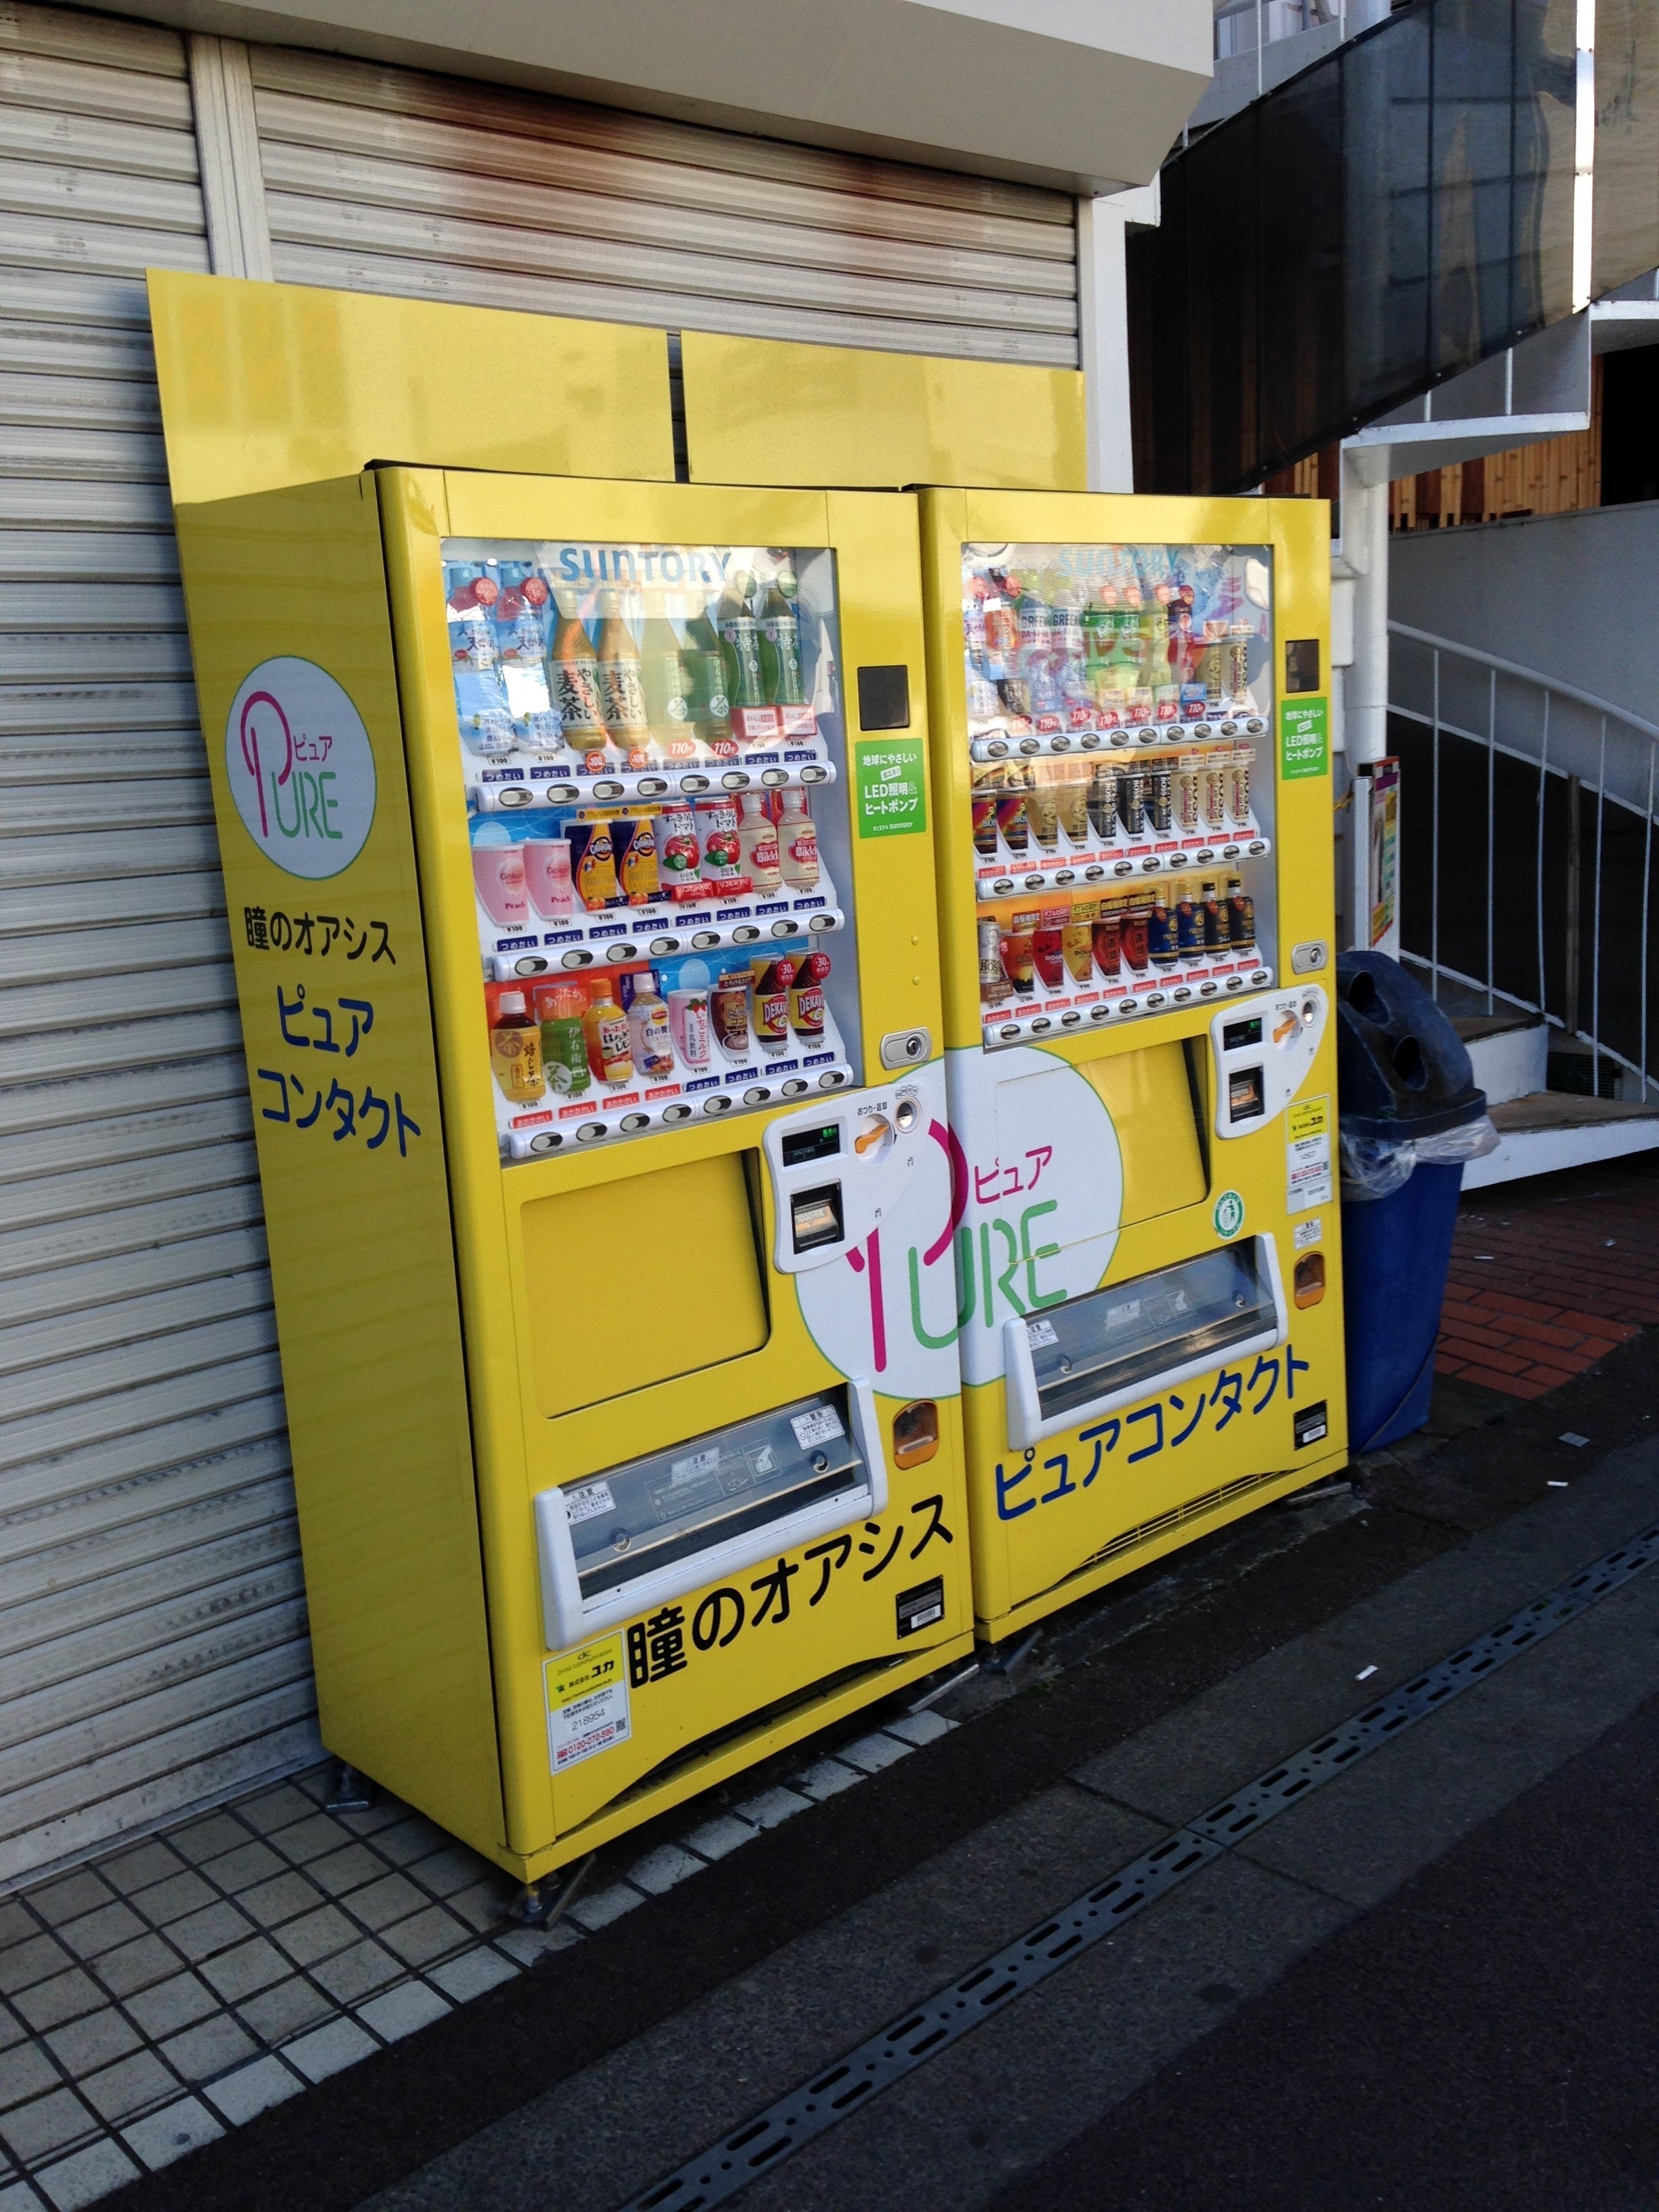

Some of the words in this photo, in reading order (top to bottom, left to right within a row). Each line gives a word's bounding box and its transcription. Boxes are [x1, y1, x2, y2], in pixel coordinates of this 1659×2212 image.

[1021, 615, 1049, 629] GREEN
[1052, 613, 1079, 626] GREEN
[556, 670, 582, 720] 麦茶
[294, 734, 333, 761] ピュア
[747, 756, 777, 764] つめたい
[785, 752, 816, 761] つめたい
[862, 753, 917, 766] 地球にやさしい
[241, 691, 342, 838] PURE
[486, 773, 521, 781] つめたい
[533, 770, 568, 778] つめたい
[865, 798, 918, 815] ヒートポンプ
[758, 906, 786, 914] つめたい
[796, 901, 823, 909] つめたい
[678, 916, 710, 925] つめたい
[720, 911, 748, 920] つめたい
[636, 922, 666, 932] つめたい
[243, 905, 396, 965] 瞳のオアシス
[548, 935, 581, 944] つめたい
[592, 929, 624, 938] つめたい
[501, 941, 535, 949] つめたい
[276, 984, 374, 1057] ピュア
[696, 1009, 708, 1059] いちごミルク
[806, 1055, 833, 1065] つめたい
[769, 1063, 796, 1073] つめたい
[728, 1071, 756, 1082] つめたい
[690, 1080, 718, 1090] つめたい
[258, 1069, 421, 1157] コンタクト
[974, 1145, 1053, 1204] ピュア
[846, 1118, 1068, 1372] PURE
[996, 1344, 1310, 1521] ピュアコンタクト
[626, 1494, 954, 1690] 瞳のオアシス
[572, 1708, 606, 1732] 218954
